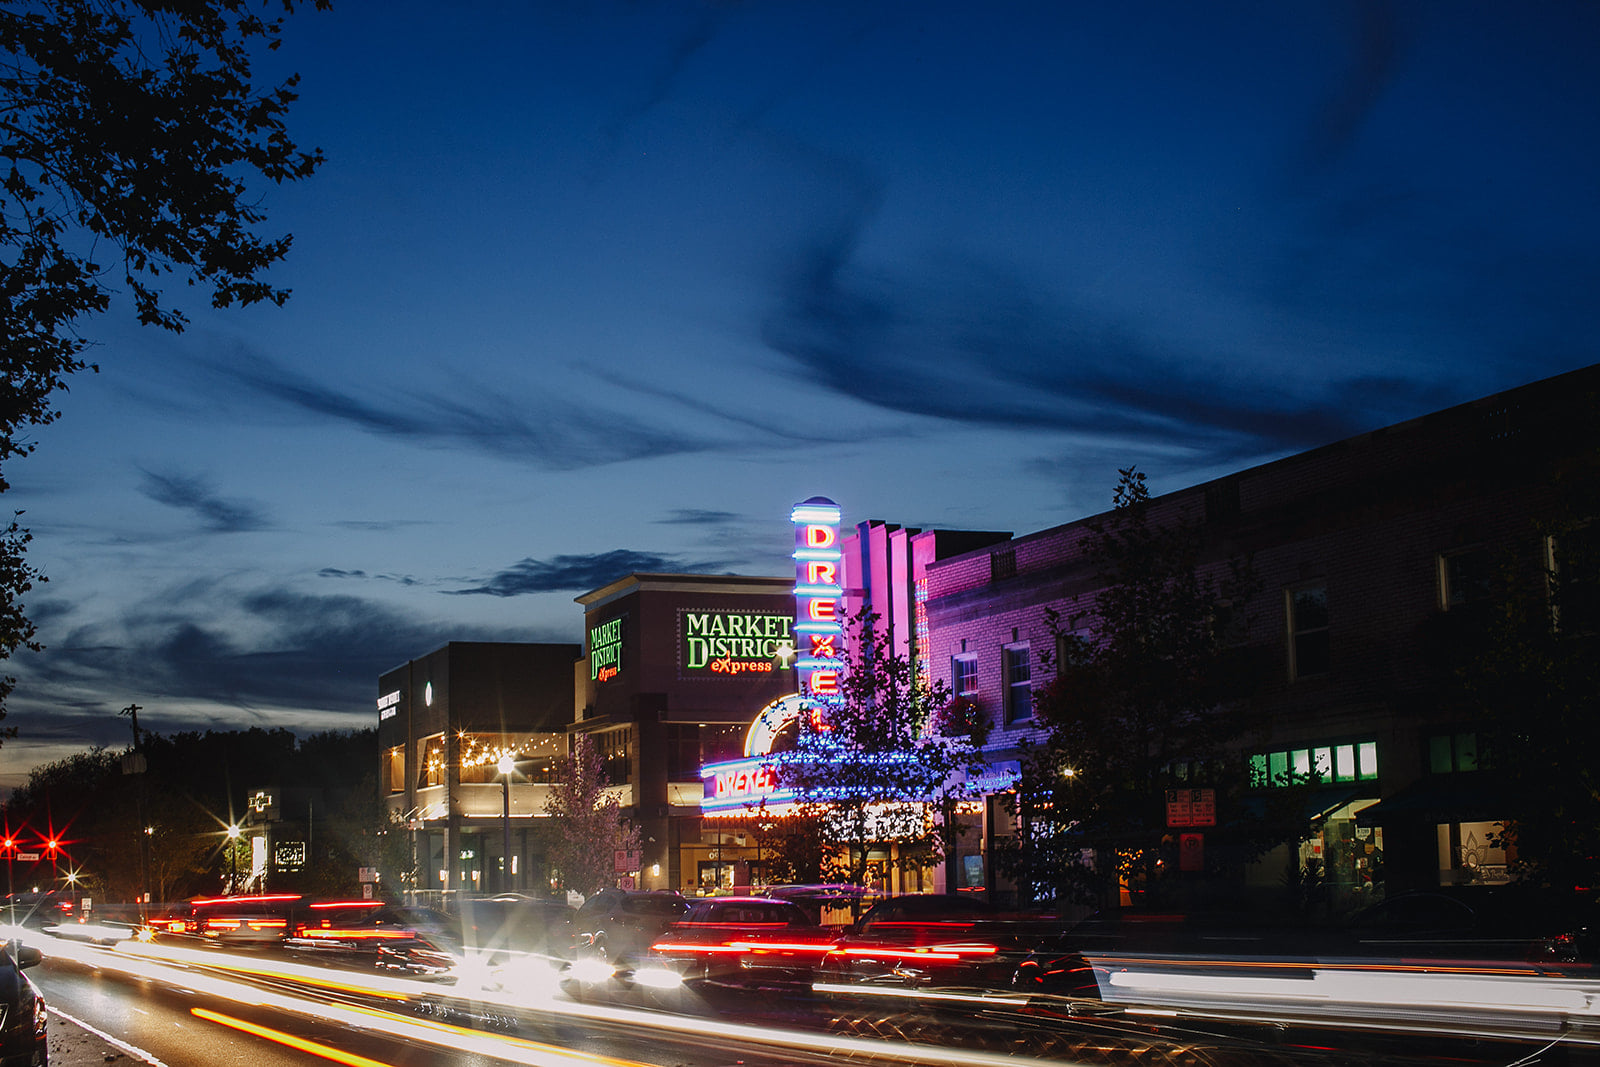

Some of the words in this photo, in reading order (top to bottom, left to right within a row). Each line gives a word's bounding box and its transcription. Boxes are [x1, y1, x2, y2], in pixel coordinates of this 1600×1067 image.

[591, 618, 622, 650] MARKET
[687, 614, 794, 638] MARKET
[806, 524, 839, 732] DREXEL
[591, 641, 622, 680] DISTRICT
[687, 637, 794, 670] DISTRICT
[714, 766, 775, 798] DREXEL
